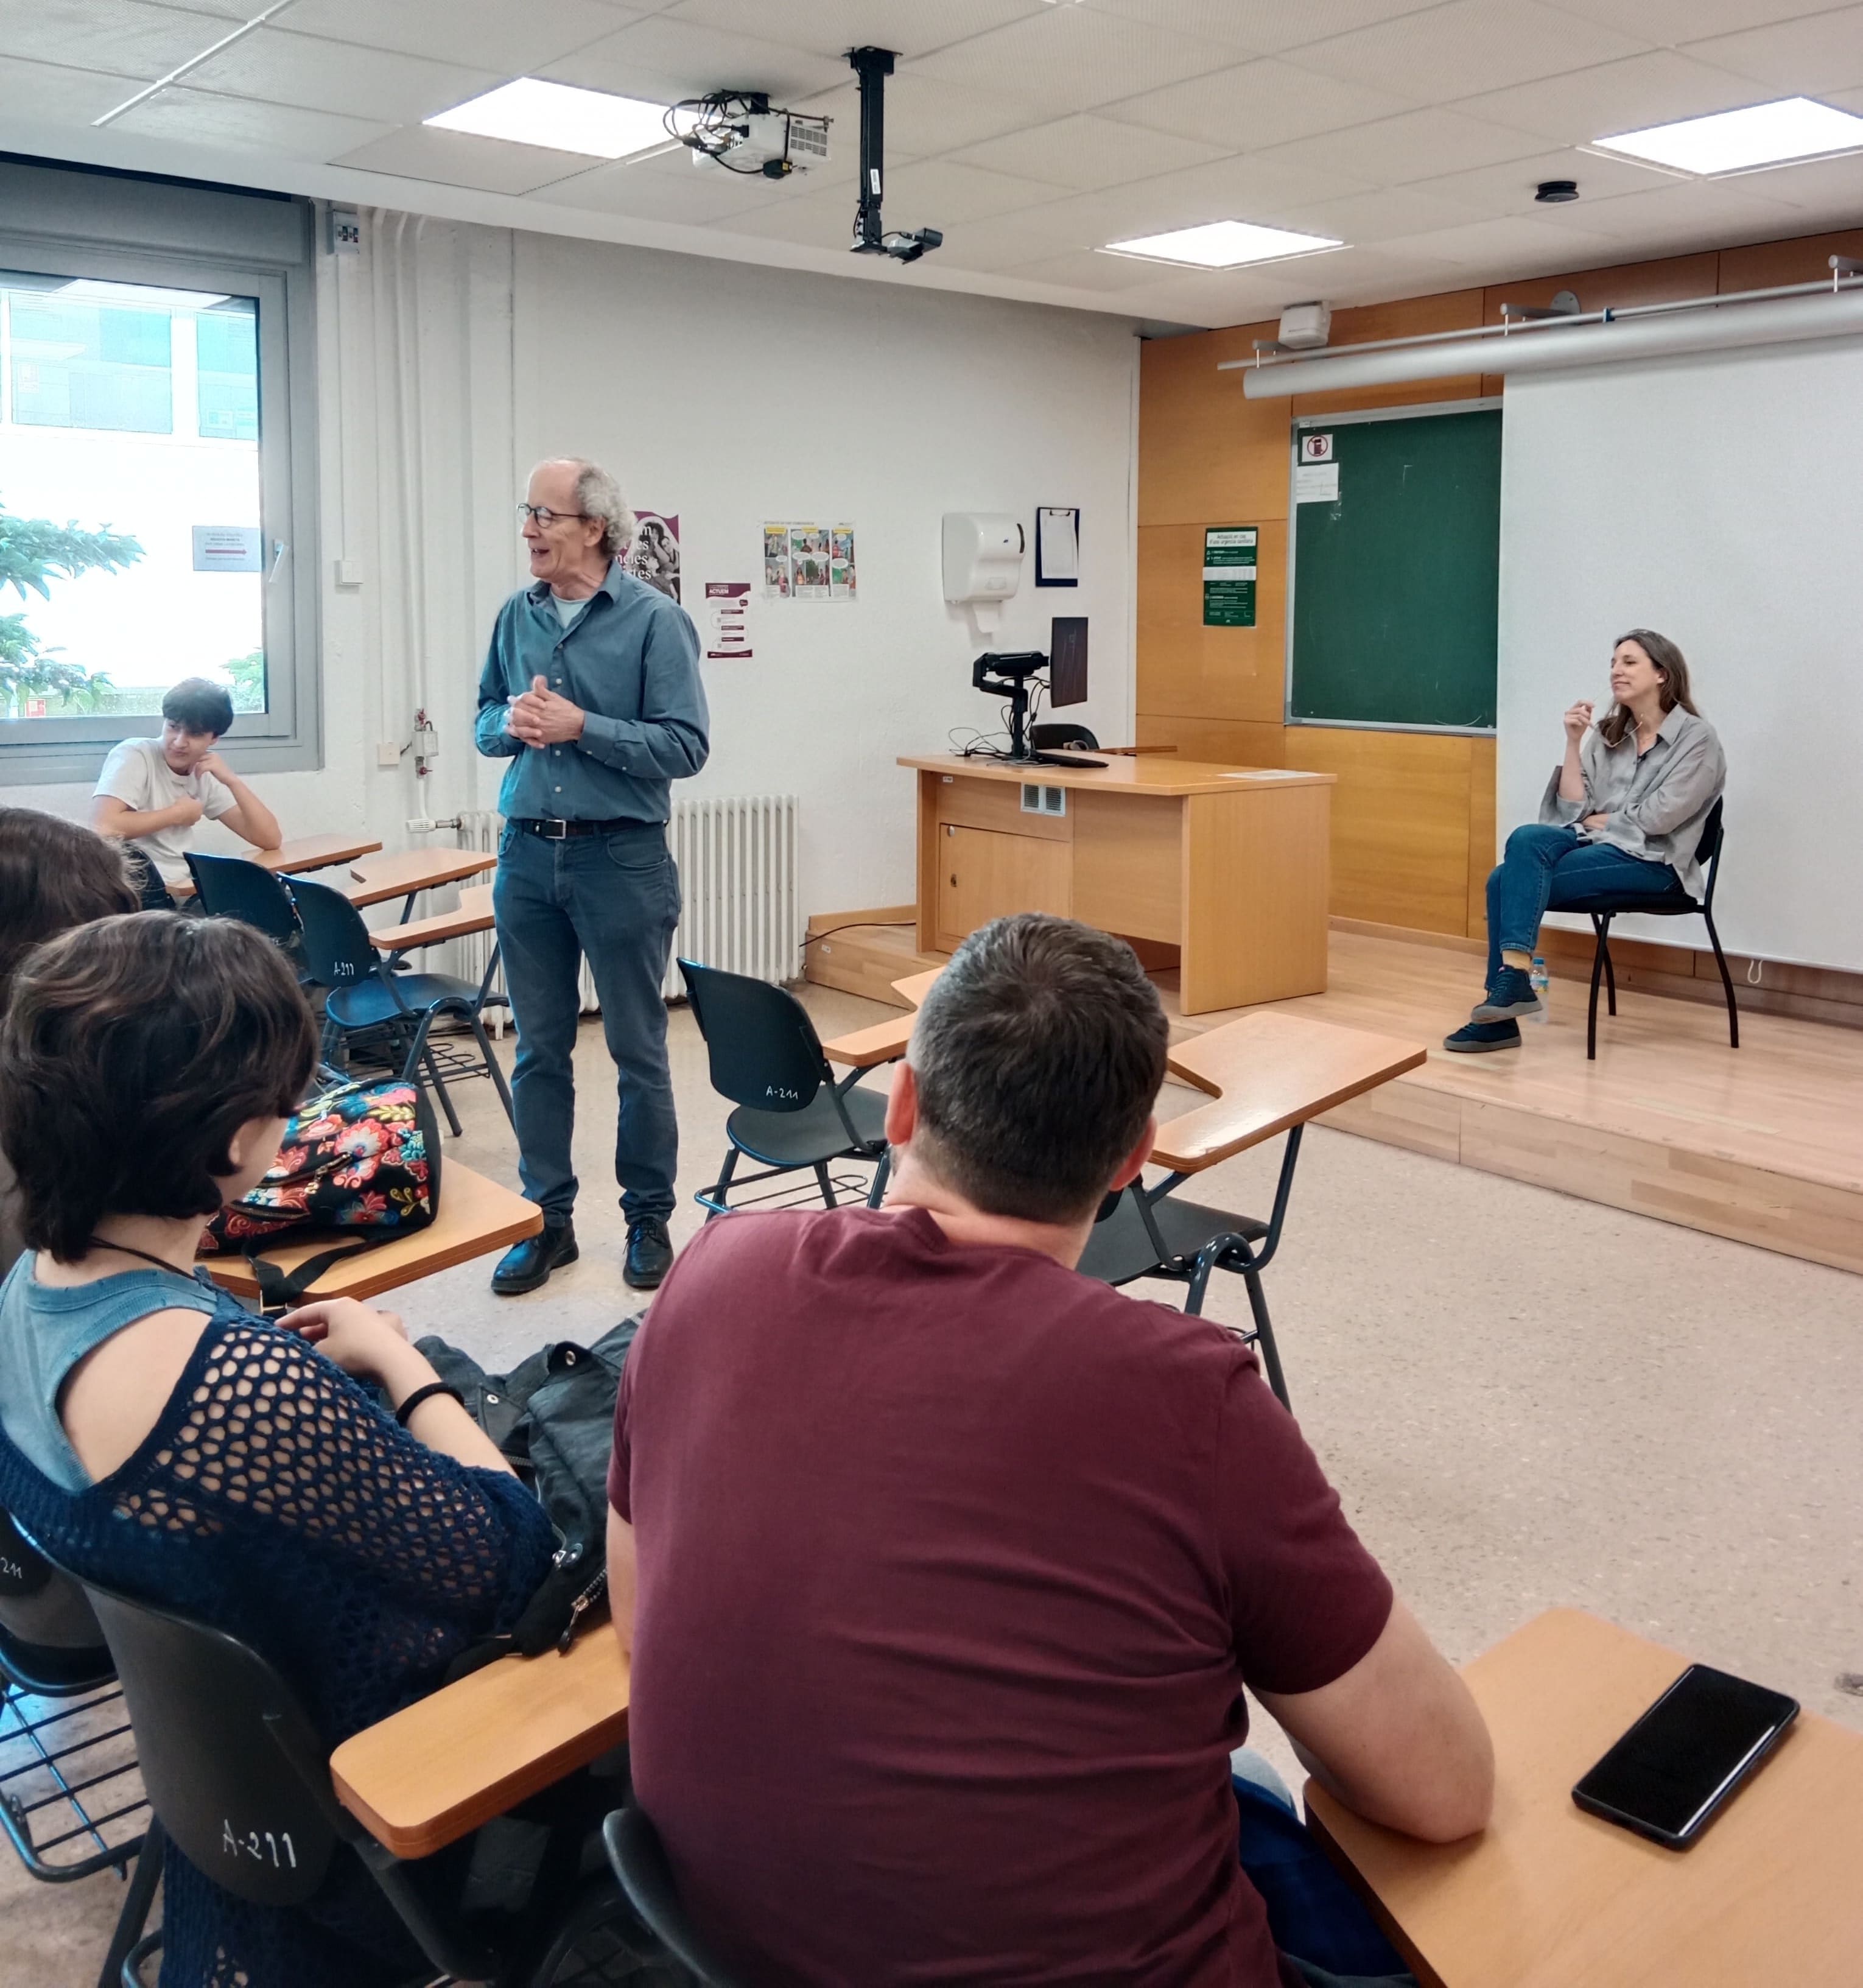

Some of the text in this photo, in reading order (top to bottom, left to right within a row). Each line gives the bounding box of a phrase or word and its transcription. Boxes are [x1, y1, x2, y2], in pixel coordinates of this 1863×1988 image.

[616, 554, 648, 565] ncies
[766, 1085, 798, 1100] A-211
[223, 1818, 296, 1868] A-211
